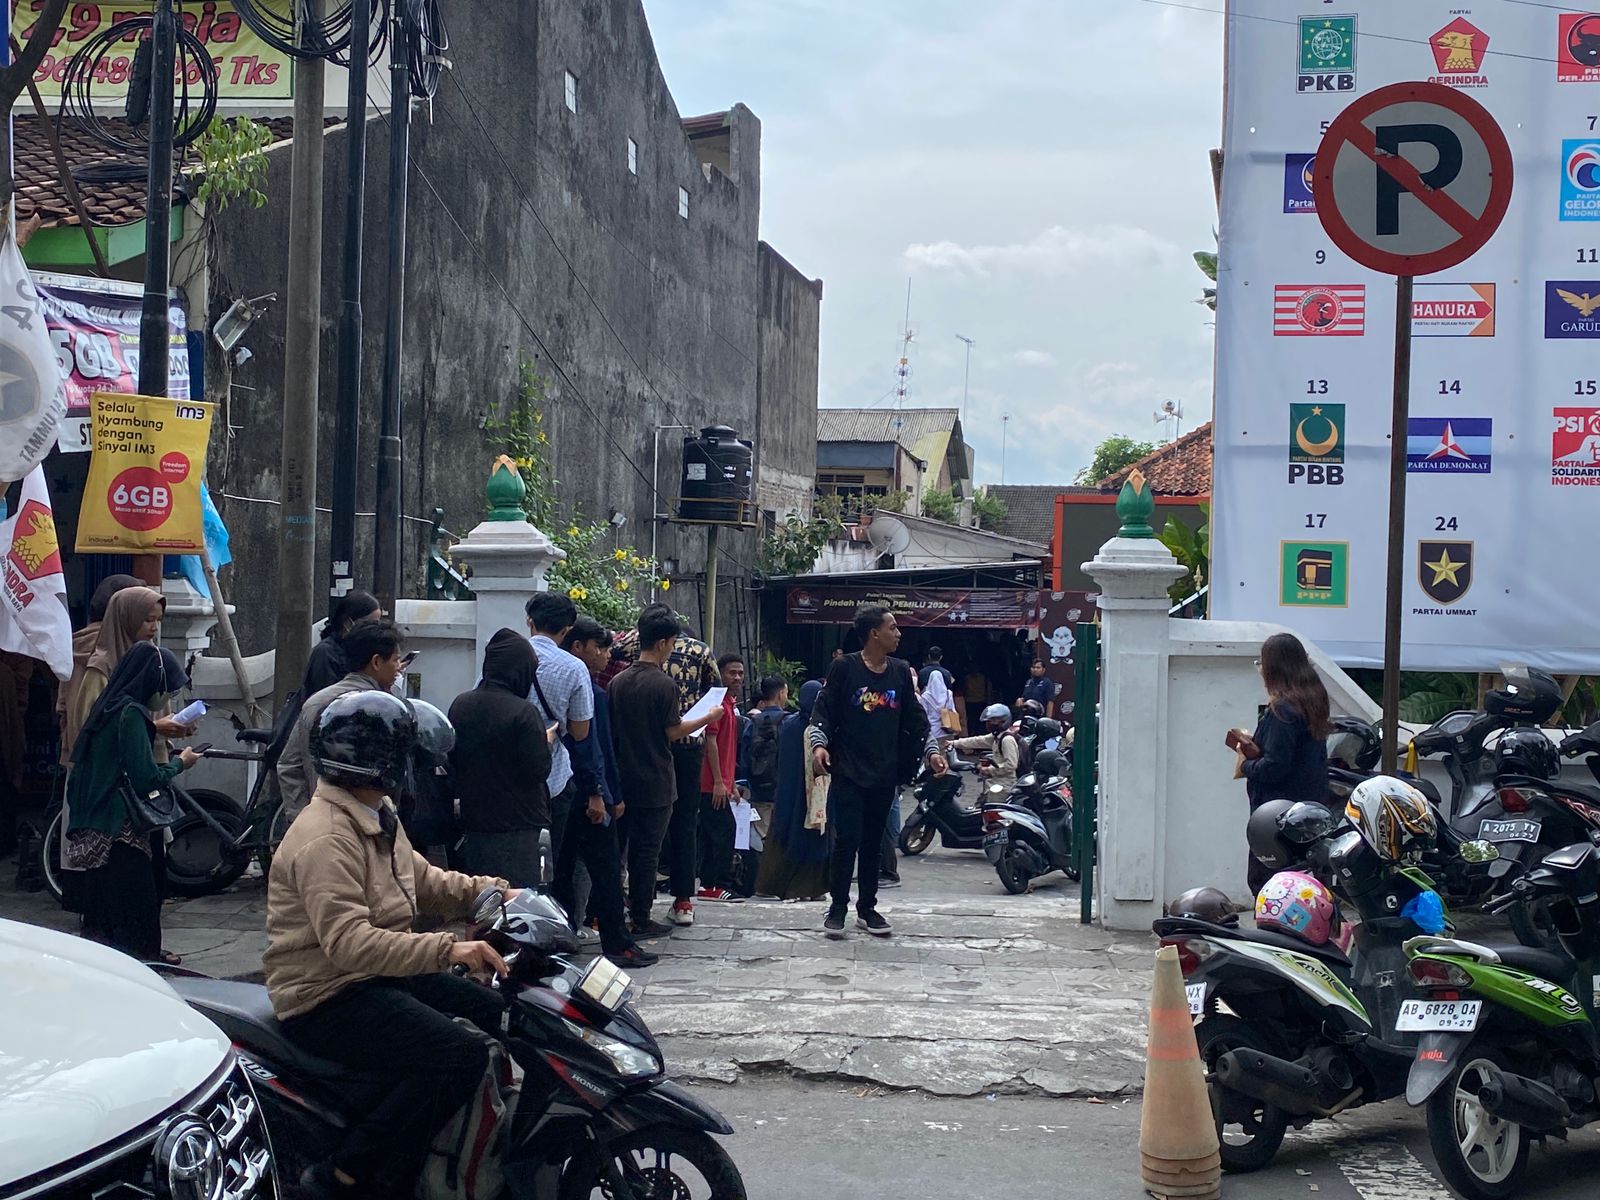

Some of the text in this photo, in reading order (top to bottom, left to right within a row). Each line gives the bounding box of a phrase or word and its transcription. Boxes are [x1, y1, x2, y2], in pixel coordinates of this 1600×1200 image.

[229, 55, 280, 85] Tks
[1298, 75, 1354, 91] PKB
[1428, 76, 1489, 85] GERINDRA
[1320, 121, 1330, 135] 5
[1587, 115, 1598, 130] 7
[1376, 124, 1463, 236] P
[1315, 250, 1326, 264] 9
[1576, 248, 1599, 263] 11
[1413, 304, 1477, 316] HANURA
[1306, 379, 1329, 394] 13
[1439, 379, 1462, 394] 14
[1574, 380, 1597, 395] 15
[97, 401, 135, 413] Selalu
[176, 403, 206, 419] im3
[97, 415, 164, 431] Nyambung
[1553, 416, 1585, 433] PSI
[97, 428, 143, 441] dengan
[97, 440, 156, 455] Sinyal IM3
[1408, 461, 1488, 470] PARTAI DEMOKRAT
[1288, 464, 1344, 485] PBB
[113, 484, 169, 508] 6GB
[1305, 513, 1328, 528] 17
[1434, 516, 1458, 531] 24
[824, 599, 855, 607] Pindah
[892, 600, 926, 609] PEMILU
[927, 601, 950, 609] 2024
[1445, 608, 1477, 616] UMMAT
[1483, 823, 1490, 832] A
[1493, 823, 1517, 834] 2075
[1402, 1003, 1419, 1015] AB
[1425, 1003, 1456, 1015] 6828
[571, 1073, 607, 1097] HONDA
